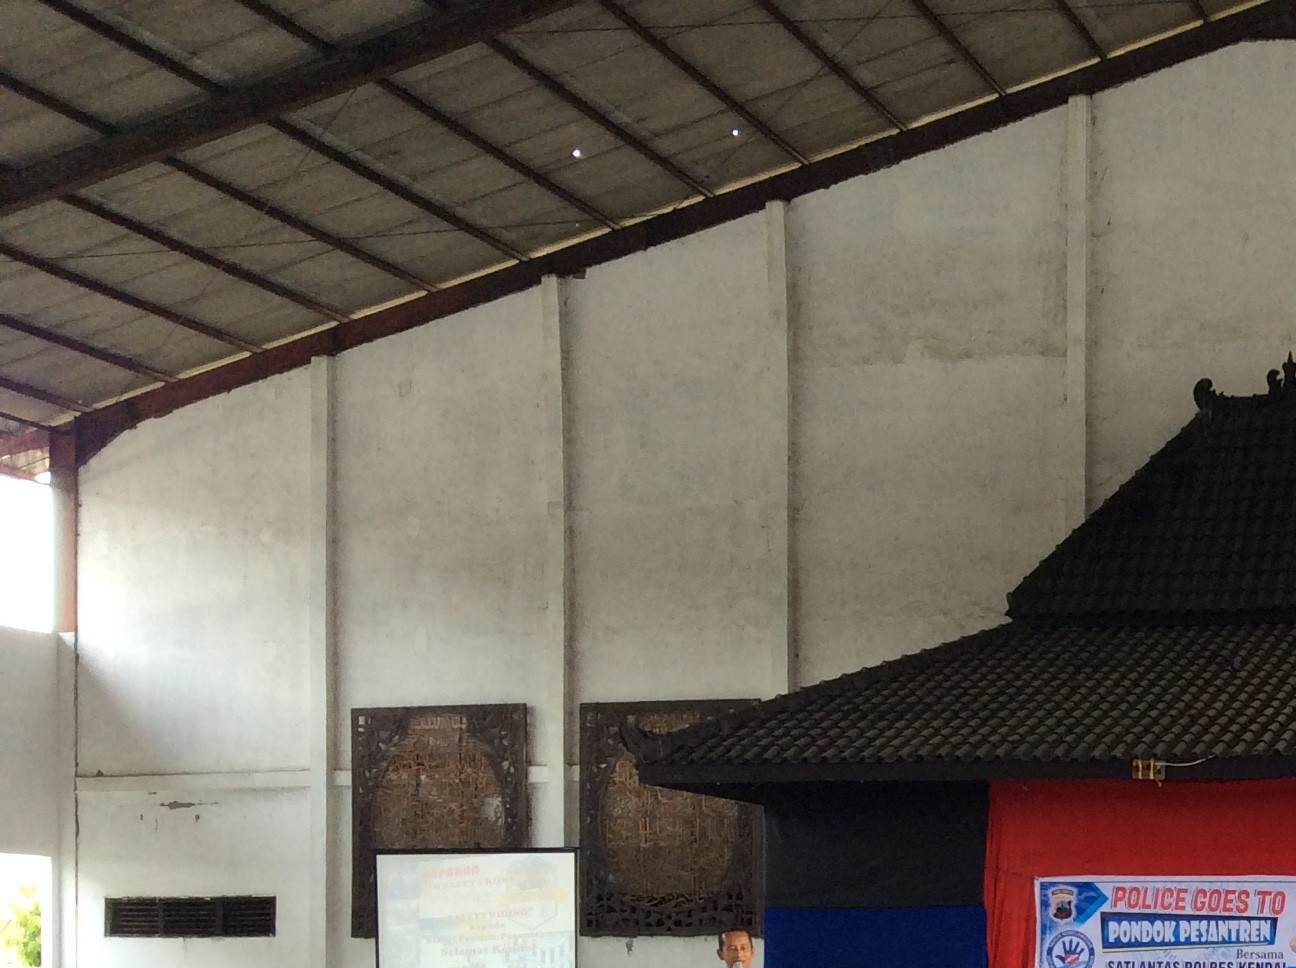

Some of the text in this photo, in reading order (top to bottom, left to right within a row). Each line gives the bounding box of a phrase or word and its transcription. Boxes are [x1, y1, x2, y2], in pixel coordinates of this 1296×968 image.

[1111, 886, 1286, 915] POLICE GOES TO
[1107, 918, 1272, 944] PONDOK PESANTREN
[1236, 948, 1284, 960] Bersama
